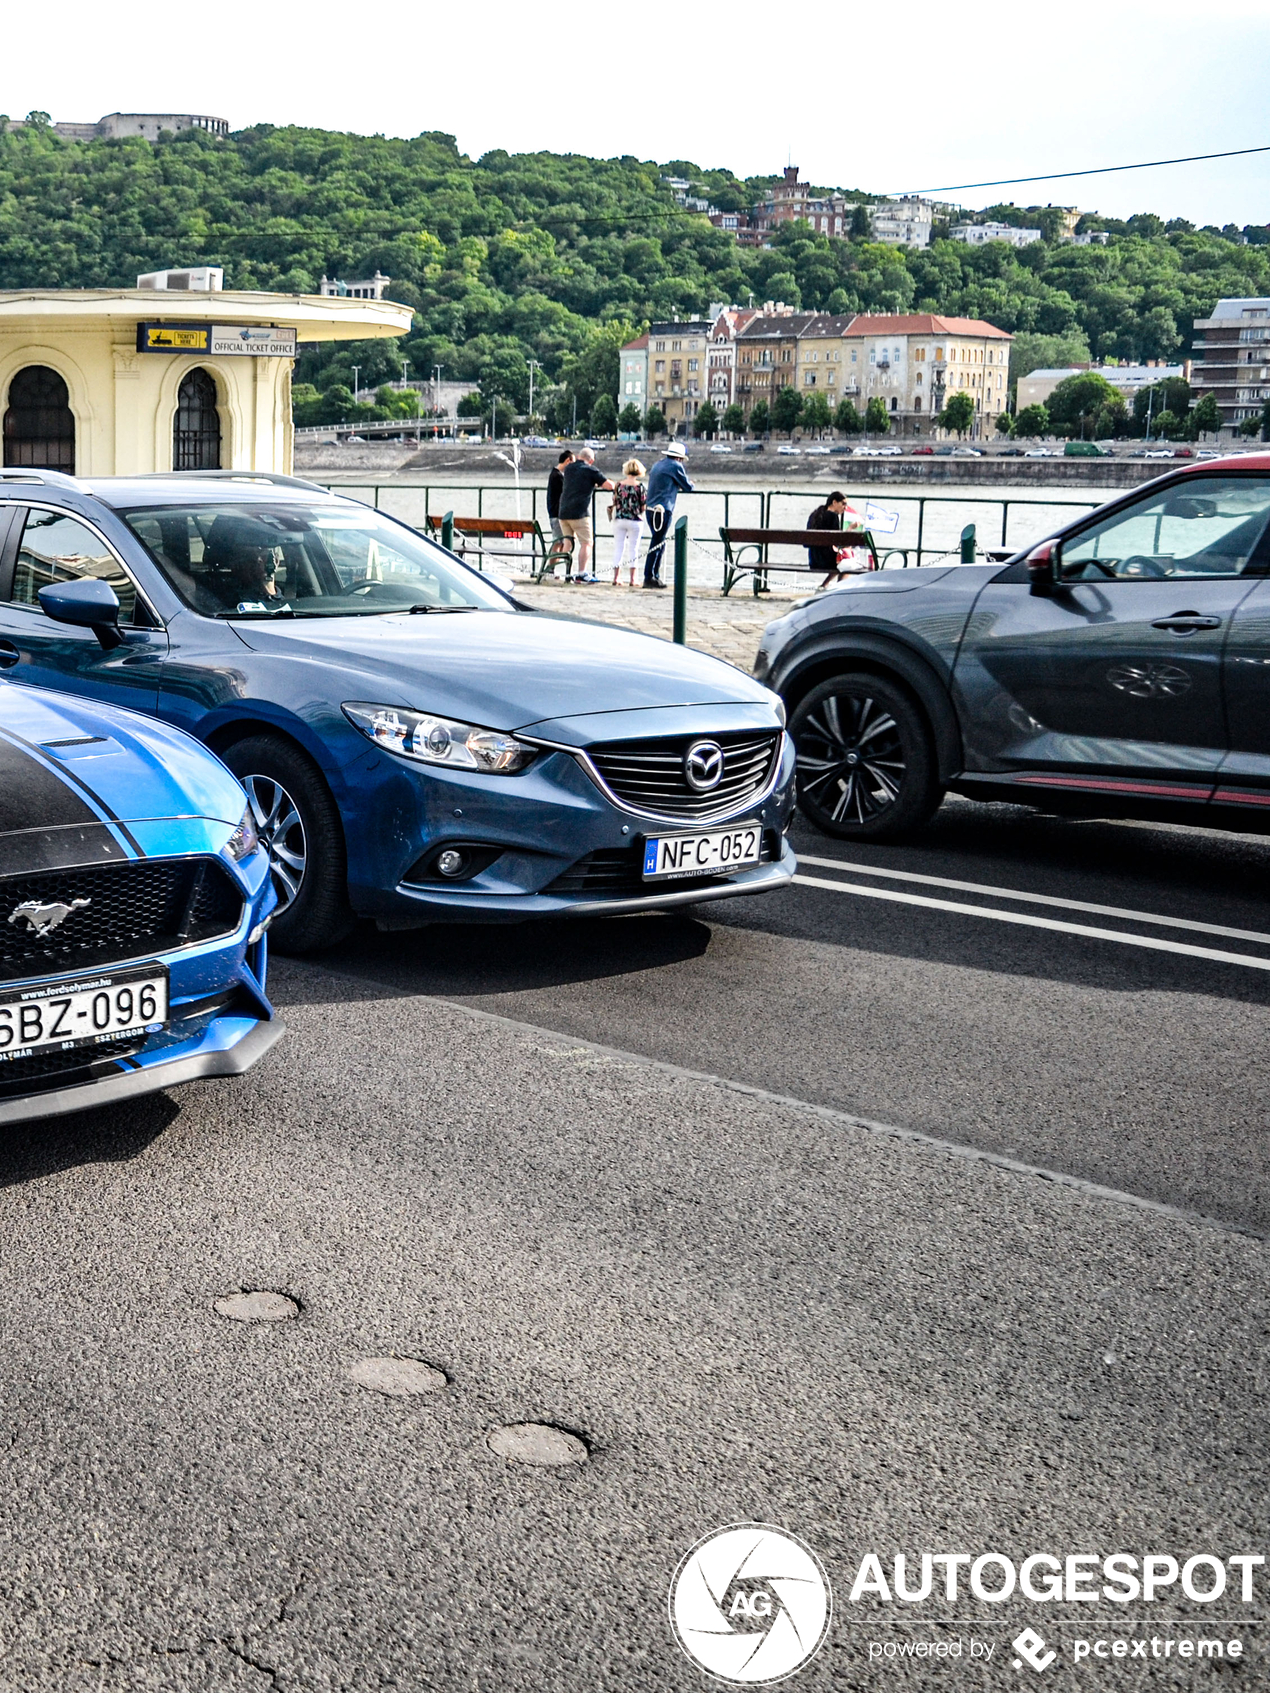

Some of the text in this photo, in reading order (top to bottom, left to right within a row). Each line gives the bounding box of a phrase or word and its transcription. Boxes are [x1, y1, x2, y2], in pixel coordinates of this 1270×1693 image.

[214, 342, 293, 353] OFFICIAL TICKET OFFICE
[662, 831, 755, 869] NFC-052
[646, 859, 654, 870] H
[20, 978, 112, 1001] www.fordsolymar.hu
[94, 1027, 144, 1043] ESZTERGOM
